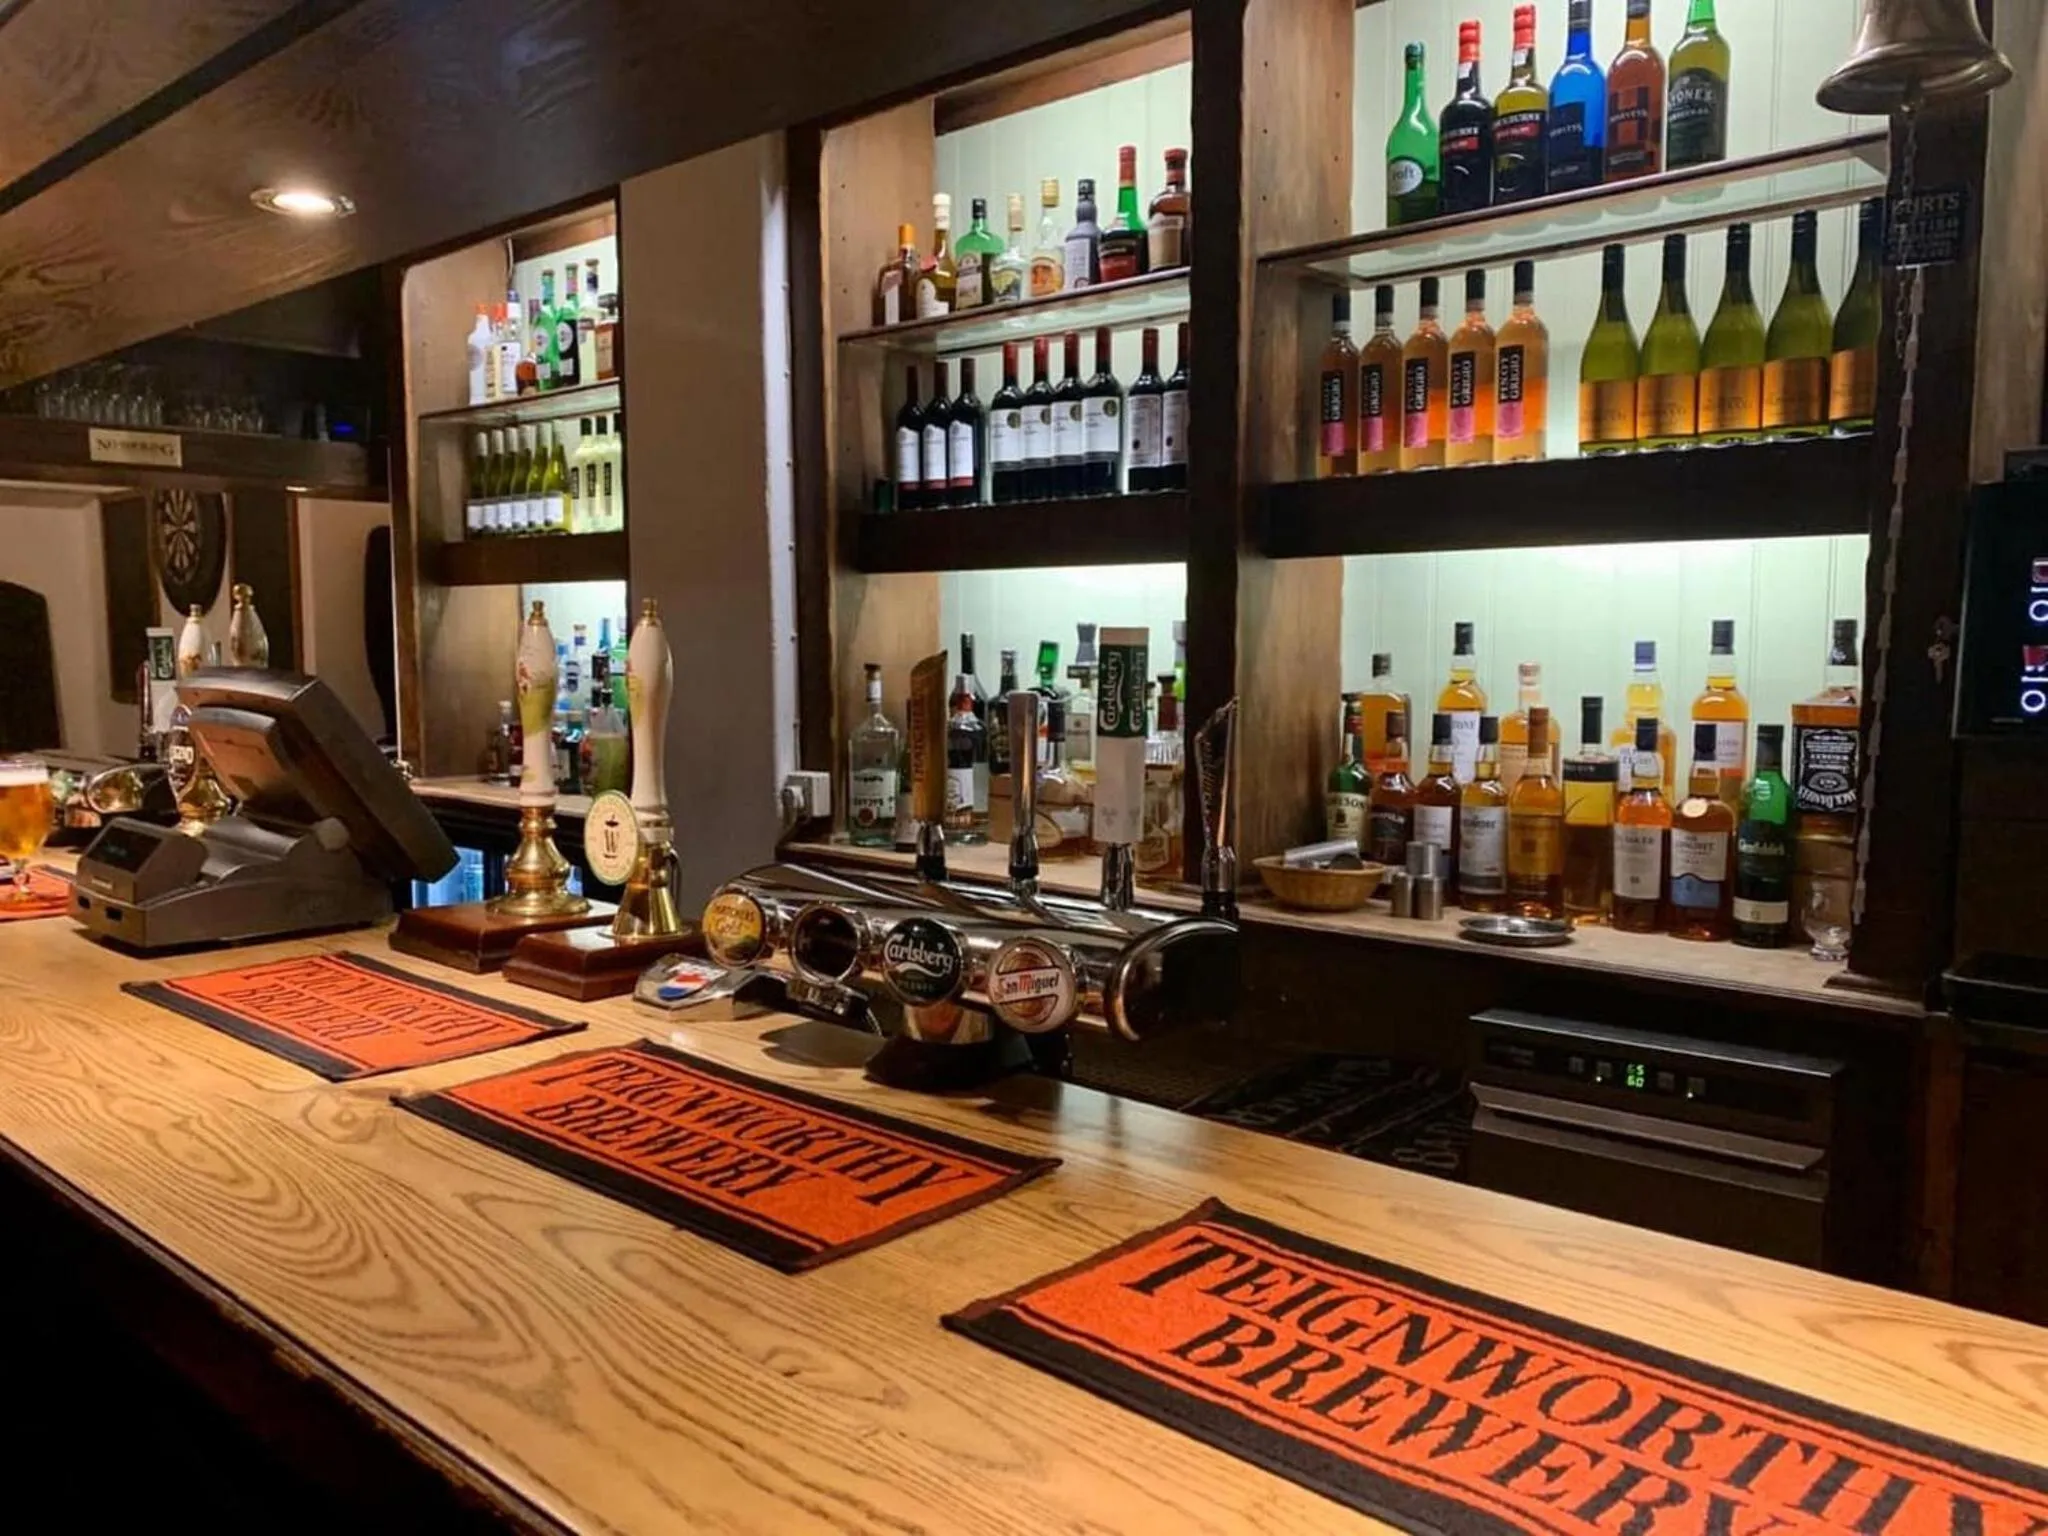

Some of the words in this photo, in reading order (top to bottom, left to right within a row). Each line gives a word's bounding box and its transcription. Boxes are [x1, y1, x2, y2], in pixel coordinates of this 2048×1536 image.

[1509, 353, 1520, 400] GRIGIO
[1099, 650, 1126, 731] Carlsberg
[884, 934, 954, 974] Carlsberg
[997, 976, 1018, 999] San
[1018, 973, 1060, 996] Miguel
[522, 1094, 827, 1198] BREWERY
[533, 1057, 979, 1206] TEIGNWORTHY
